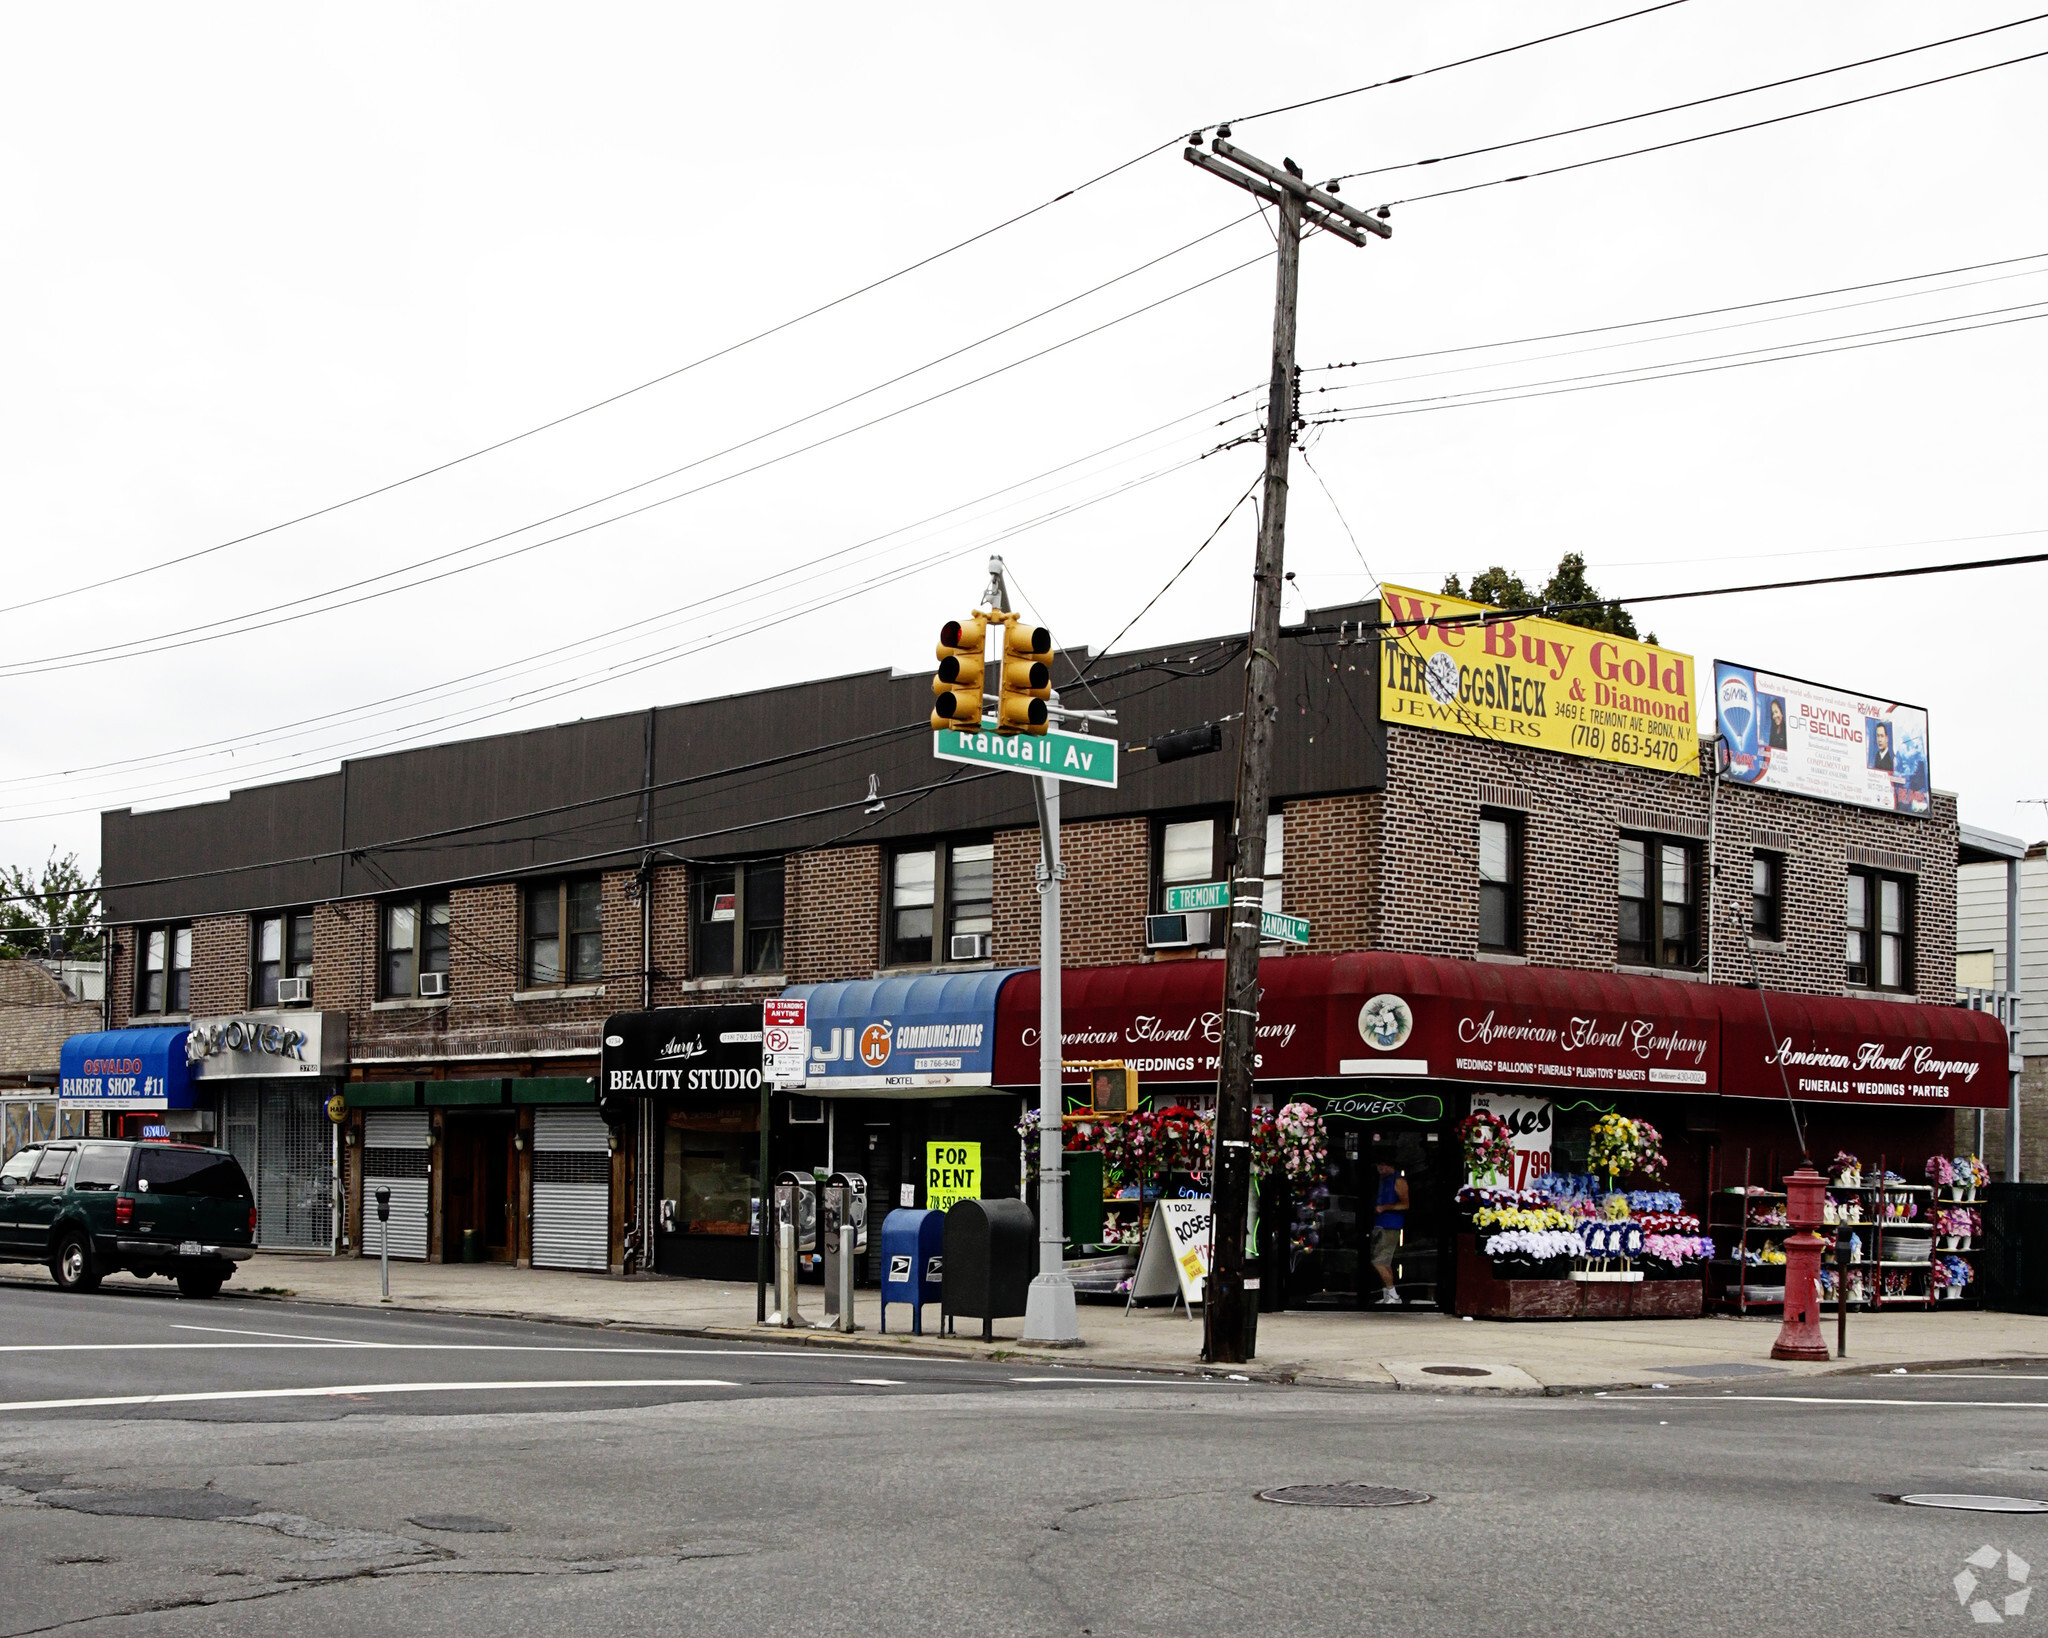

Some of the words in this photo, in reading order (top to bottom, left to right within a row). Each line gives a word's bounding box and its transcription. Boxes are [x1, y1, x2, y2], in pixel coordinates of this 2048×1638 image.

[1386, 592, 1465, 647] We
[1482, 618, 1575, 680] Buy
[1590, 642, 1687, 697] Gold
[1569, 677, 1586, 702] &
[1594, 681, 1690, 724] Diamond
[1392, 698, 1541, 738] JEWELERS
[1555, 701, 1577, 720] 3469
[1580, 707, 1586, 722] E.
[1590, 708, 1627, 729] TREMONT
[1629, 716, 1645, 733] AVE.
[1677, 726, 1693, 742] N.Y.
[1801, 703, 1850, 726] BUYING
[1789, 715, 1807, 731] OR
[1809, 720, 1863, 743] SELLING
[959, 731, 1051, 764] Randall
[1064, 744, 1093, 771] Av
[1571, 724, 1605, 753] (718)
[1611, 731, 1678, 762] 863-5470
[1169, 891, 1175, 909] E
[1180, 886, 1221, 908] TREMONT
[1223, 887, 1229, 896] A
[1261, 915, 1297, 940] RANDALL
[1297, 921, 1307, 933] AV
[736, 1033, 762, 1041] 792-169
[896, 1024, 983, 1049] COMMUNICATIONS
[1125, 1015, 1197, 1043] Floral
[1200, 1012, 1297, 1048] Cany
[1458, 1010, 1558, 1045] American
[1560, 1017, 1628, 1051] Floral
[1630, 1019, 1707, 1065] Company
[84, 1058, 142, 1075] OSVALDO
[765, 1055, 773, 1066] 2
[810, 1063, 825, 1072] 3752
[1125, 1057, 1195, 1072] WEDDINGS
[1456, 1058, 1493, 1072] WEDDINGS
[1497, 1061, 1534, 1074] BALLOONS
[1537, 1065, 1572, 1076] FUNERALS
[1617, 1070, 1646, 1081] BASKETS
[1765, 1037, 1850, 1069] American
[1853, 1043, 1912, 1071] Floral
[1914, 1046, 1980, 1083] Company
[62, 1078, 103, 1097] BARBER
[107, 1077, 136, 1097] SHOP
[144, 1076, 165, 1096] #11
[609, 1070, 683, 1090] BEAUTY
[688, 1068, 762, 1090] STUDIO
[885, 1077, 914, 1085] NEXTEL
[1799, 1079, 1849, 1093] FUNERALS
[1857, 1082, 1905, 1096] WEDDINGS
[1913, 1085, 1949, 1097] PARTIES
[1325, 1100, 1406, 1114] FLOWERS
[936, 1148, 967, 1165] FOR
[930, 1168, 974, 1188] RENT
[1174, 1204, 1196, 1212] DOZ.
[1175, 1215, 1211, 1245] ROSES
